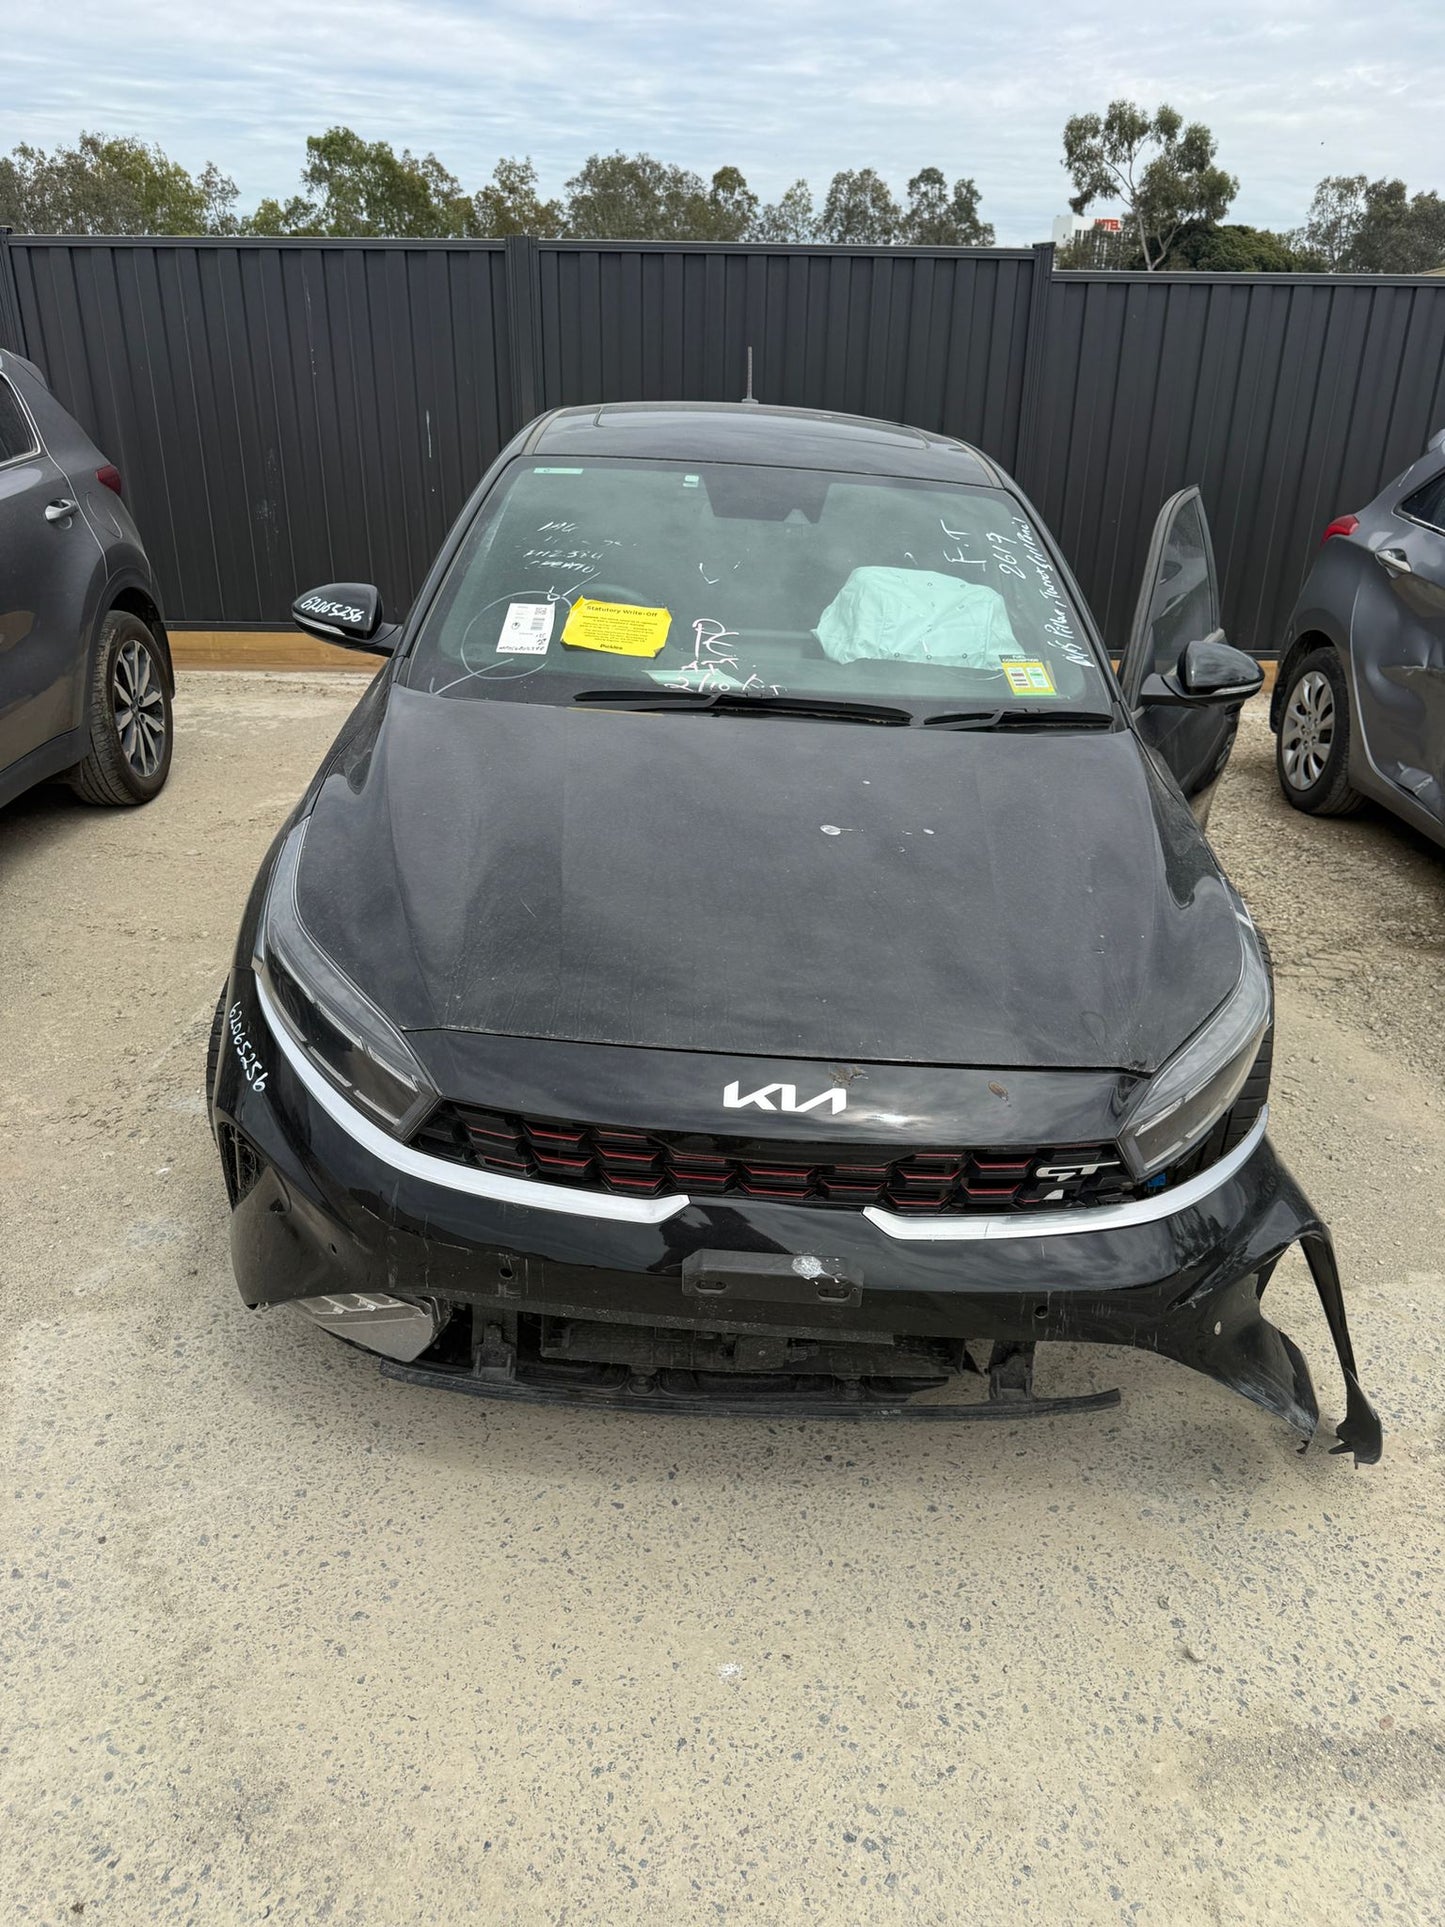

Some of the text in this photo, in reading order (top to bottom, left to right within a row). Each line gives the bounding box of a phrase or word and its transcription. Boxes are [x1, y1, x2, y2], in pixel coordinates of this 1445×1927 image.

[1094, 218, 1121, 230] TEL
[301, 596, 365, 622] 62065256
[586, 605, 622, 614] Statutory
[229, 1001, 268, 1092] 62065256
[723, 1080, 847, 1116] KIA
